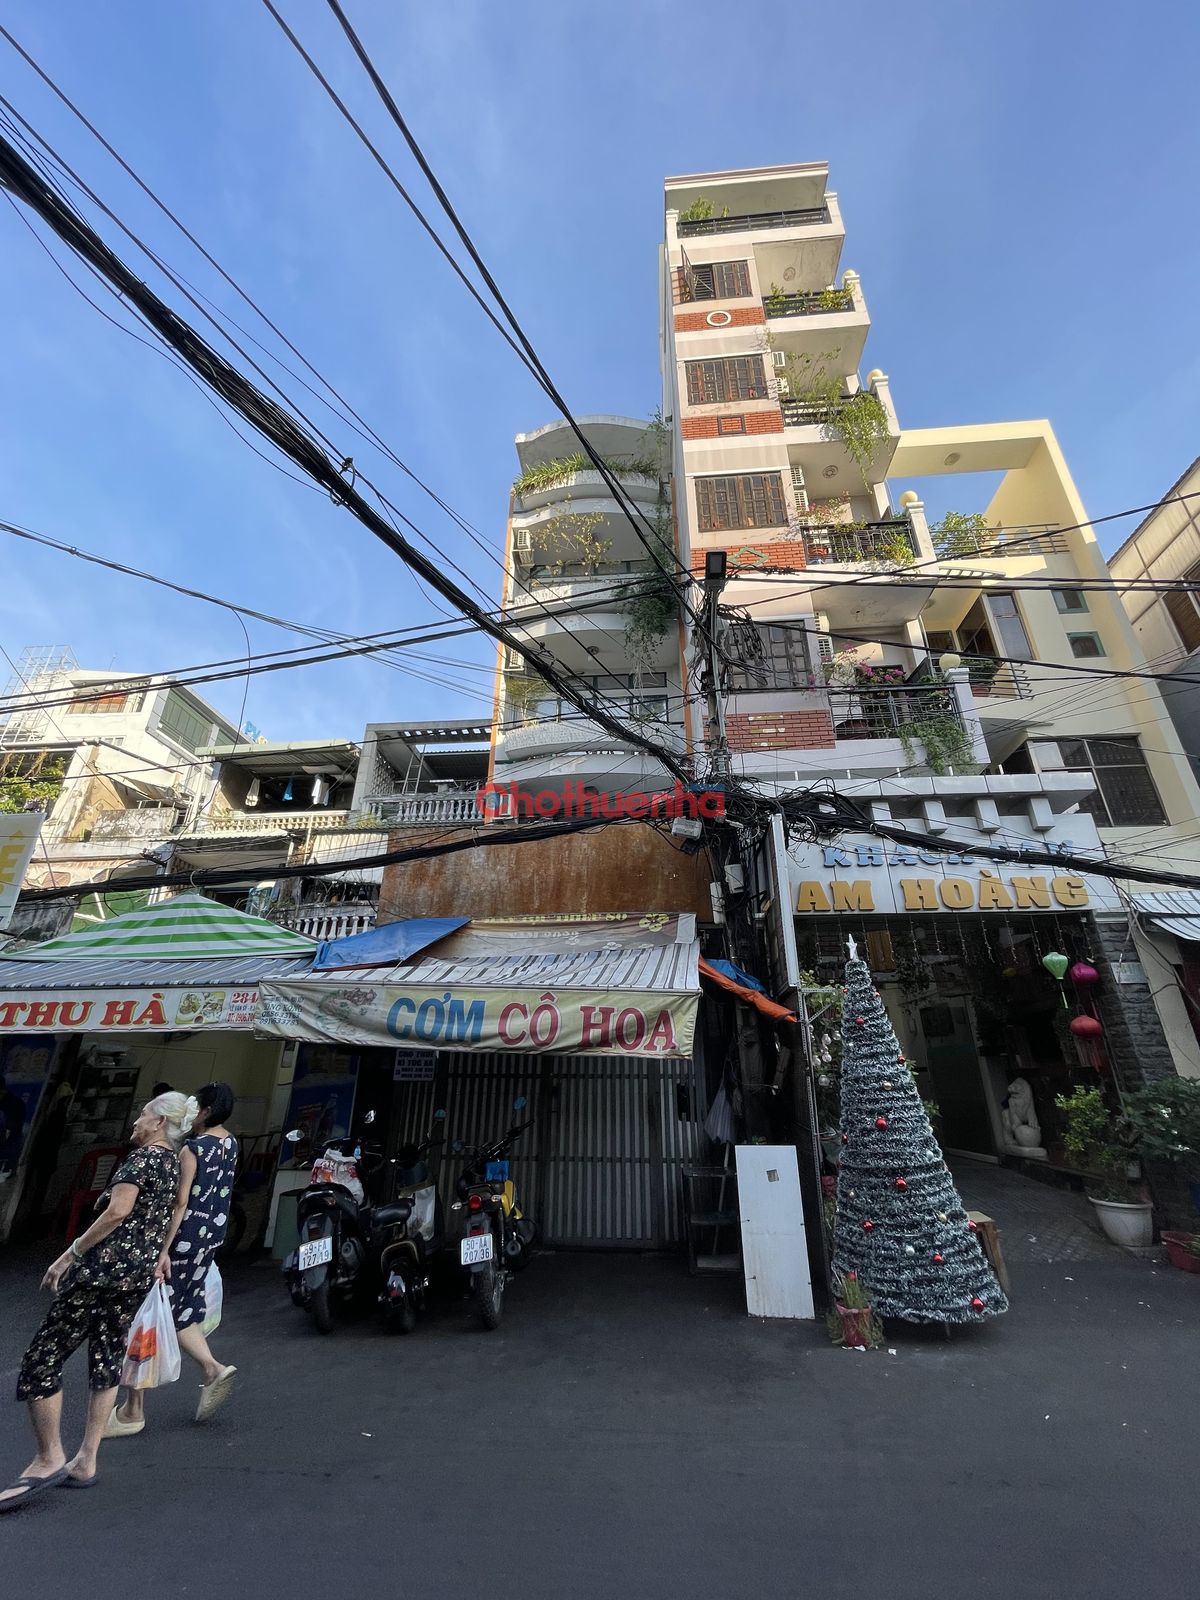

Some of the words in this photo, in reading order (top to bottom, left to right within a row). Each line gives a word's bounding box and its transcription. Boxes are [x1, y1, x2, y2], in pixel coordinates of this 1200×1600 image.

[900, 868, 1090, 910] HOÀNG
[0, 1001, 95, 1027] THU
[100, 992, 169, 1026] HÀ
[386, 991, 485, 1043] CƠM
[498, 991, 560, 1048] CÔ
[580, 1004, 677, 1051] HOA
